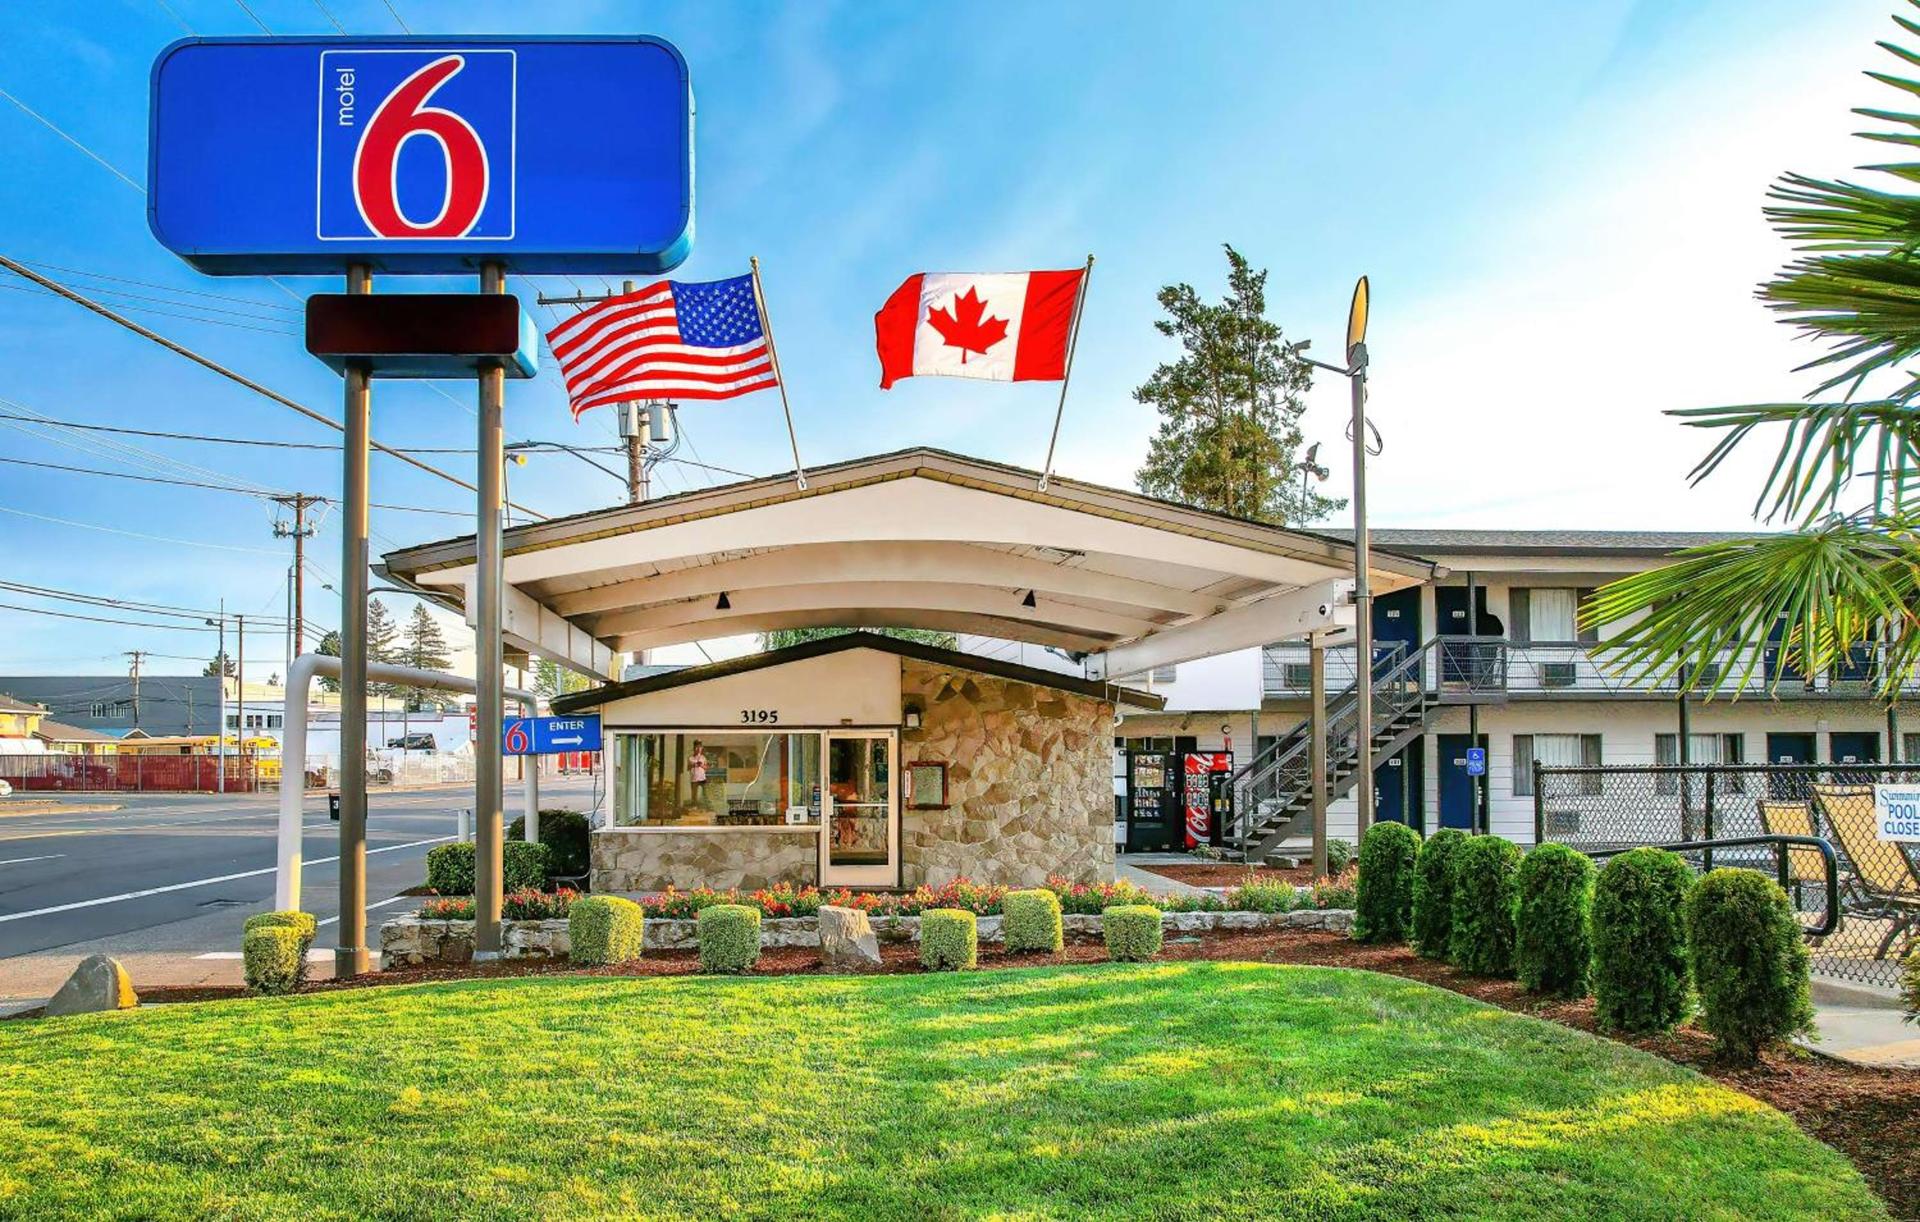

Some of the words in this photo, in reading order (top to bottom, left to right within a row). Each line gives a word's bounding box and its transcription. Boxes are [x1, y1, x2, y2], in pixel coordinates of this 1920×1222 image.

[336, 68, 355, 126] motel
[353, 54, 490, 238] 6
[741, 710, 778, 723] 3195
[549, 720, 584, 732] ENTER
[505, 721, 528, 753] 6
[1889, 804, 1920, 819] POOL
[1884, 821, 1920, 835] CLOSE
